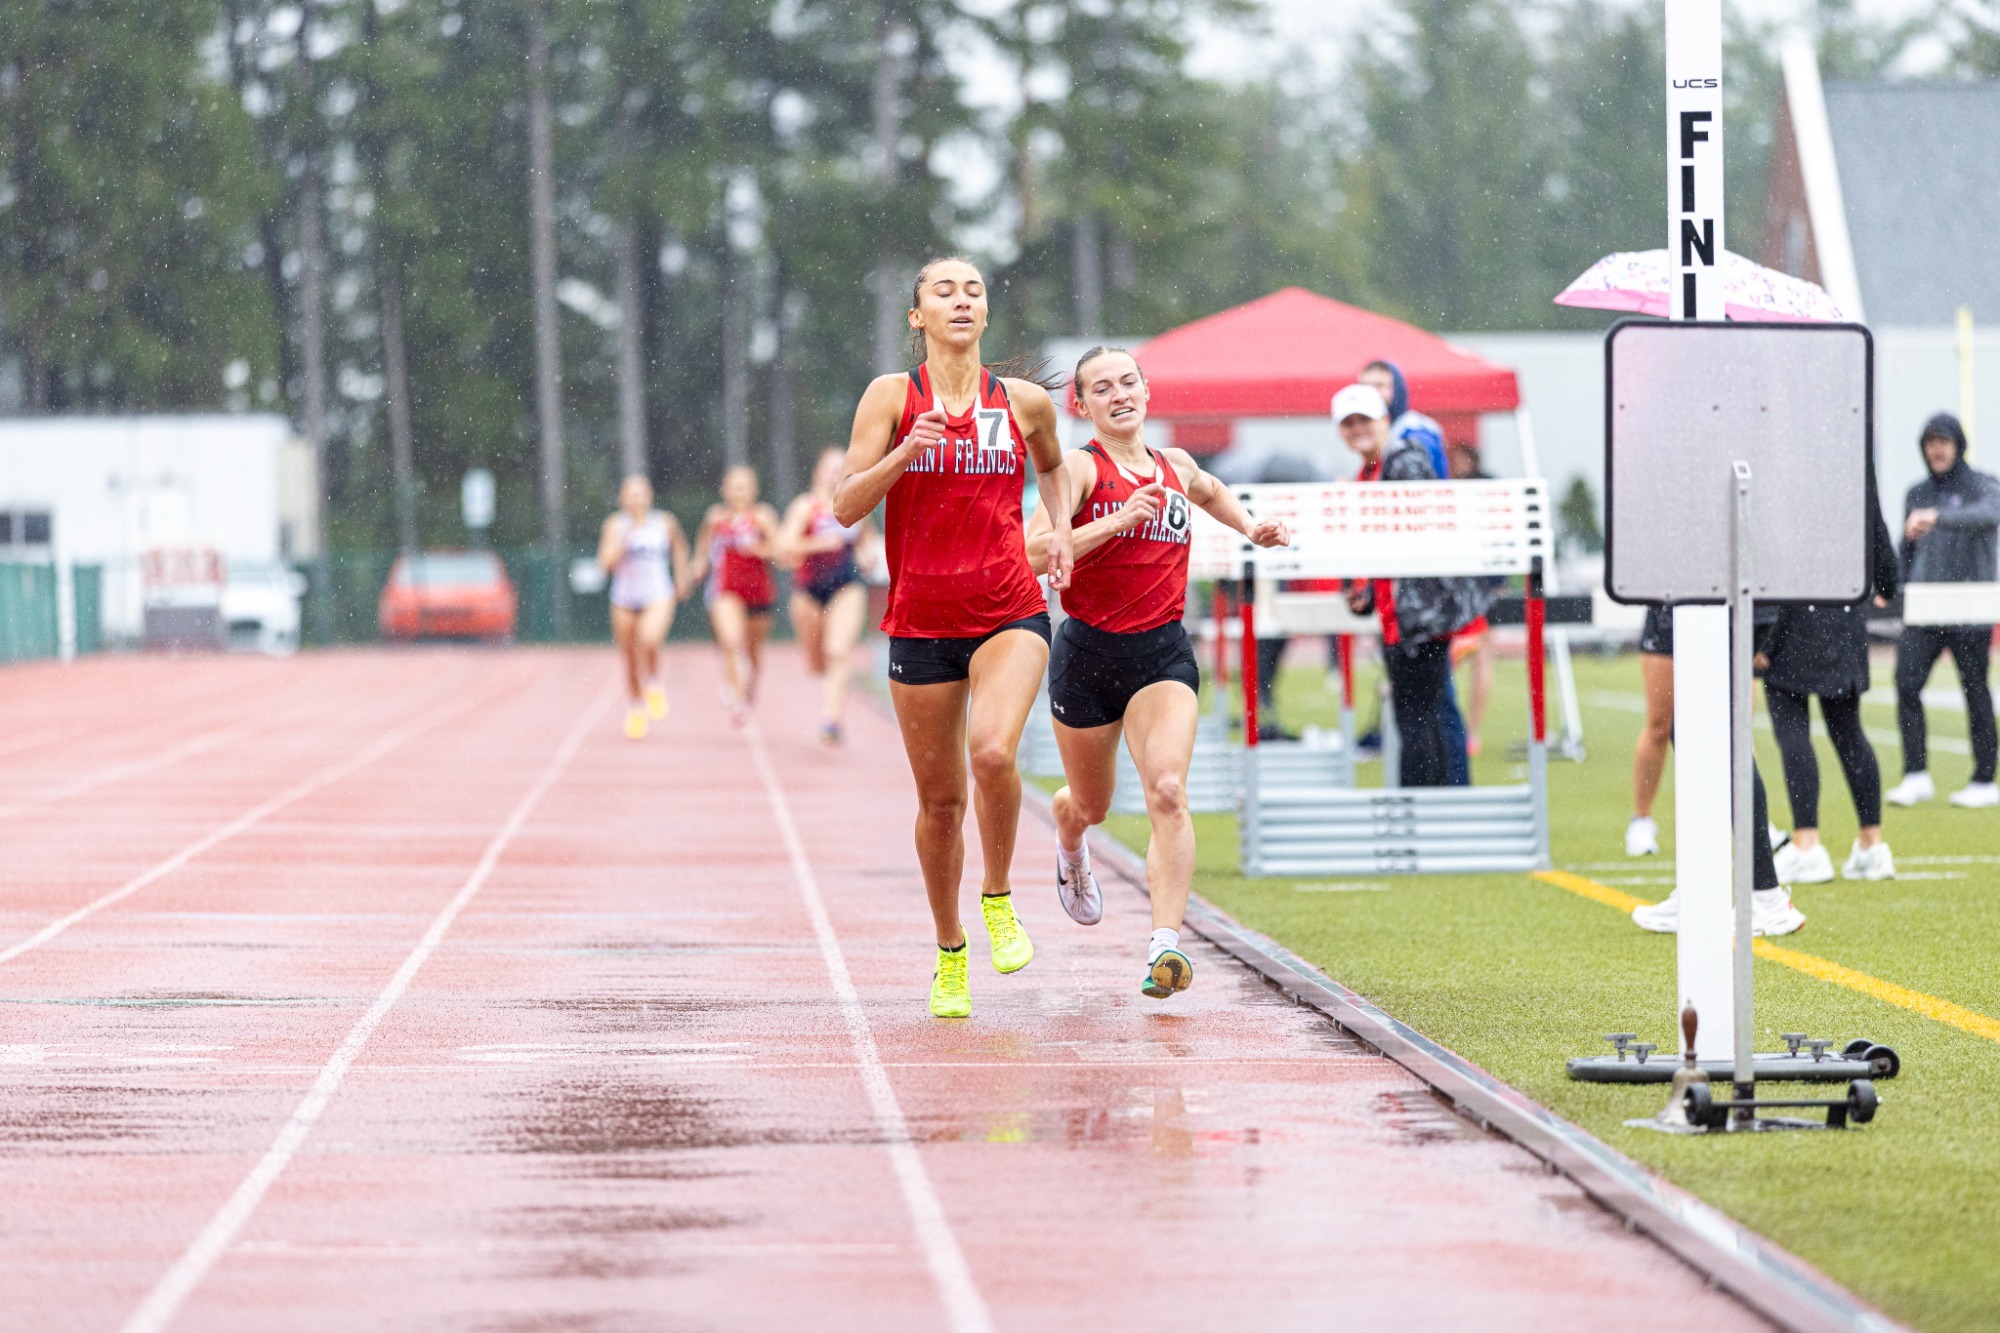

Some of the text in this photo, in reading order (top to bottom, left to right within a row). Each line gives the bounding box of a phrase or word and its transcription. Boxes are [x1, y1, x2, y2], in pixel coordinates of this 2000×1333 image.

[1673, 79, 1718, 88] UCS
[1680, 111, 1715, 318] FINI
[978, 411, 1004, 447] 7
[903, 436, 1016, 475] INT FRANCIS
[1168, 493, 1187, 531] 6
